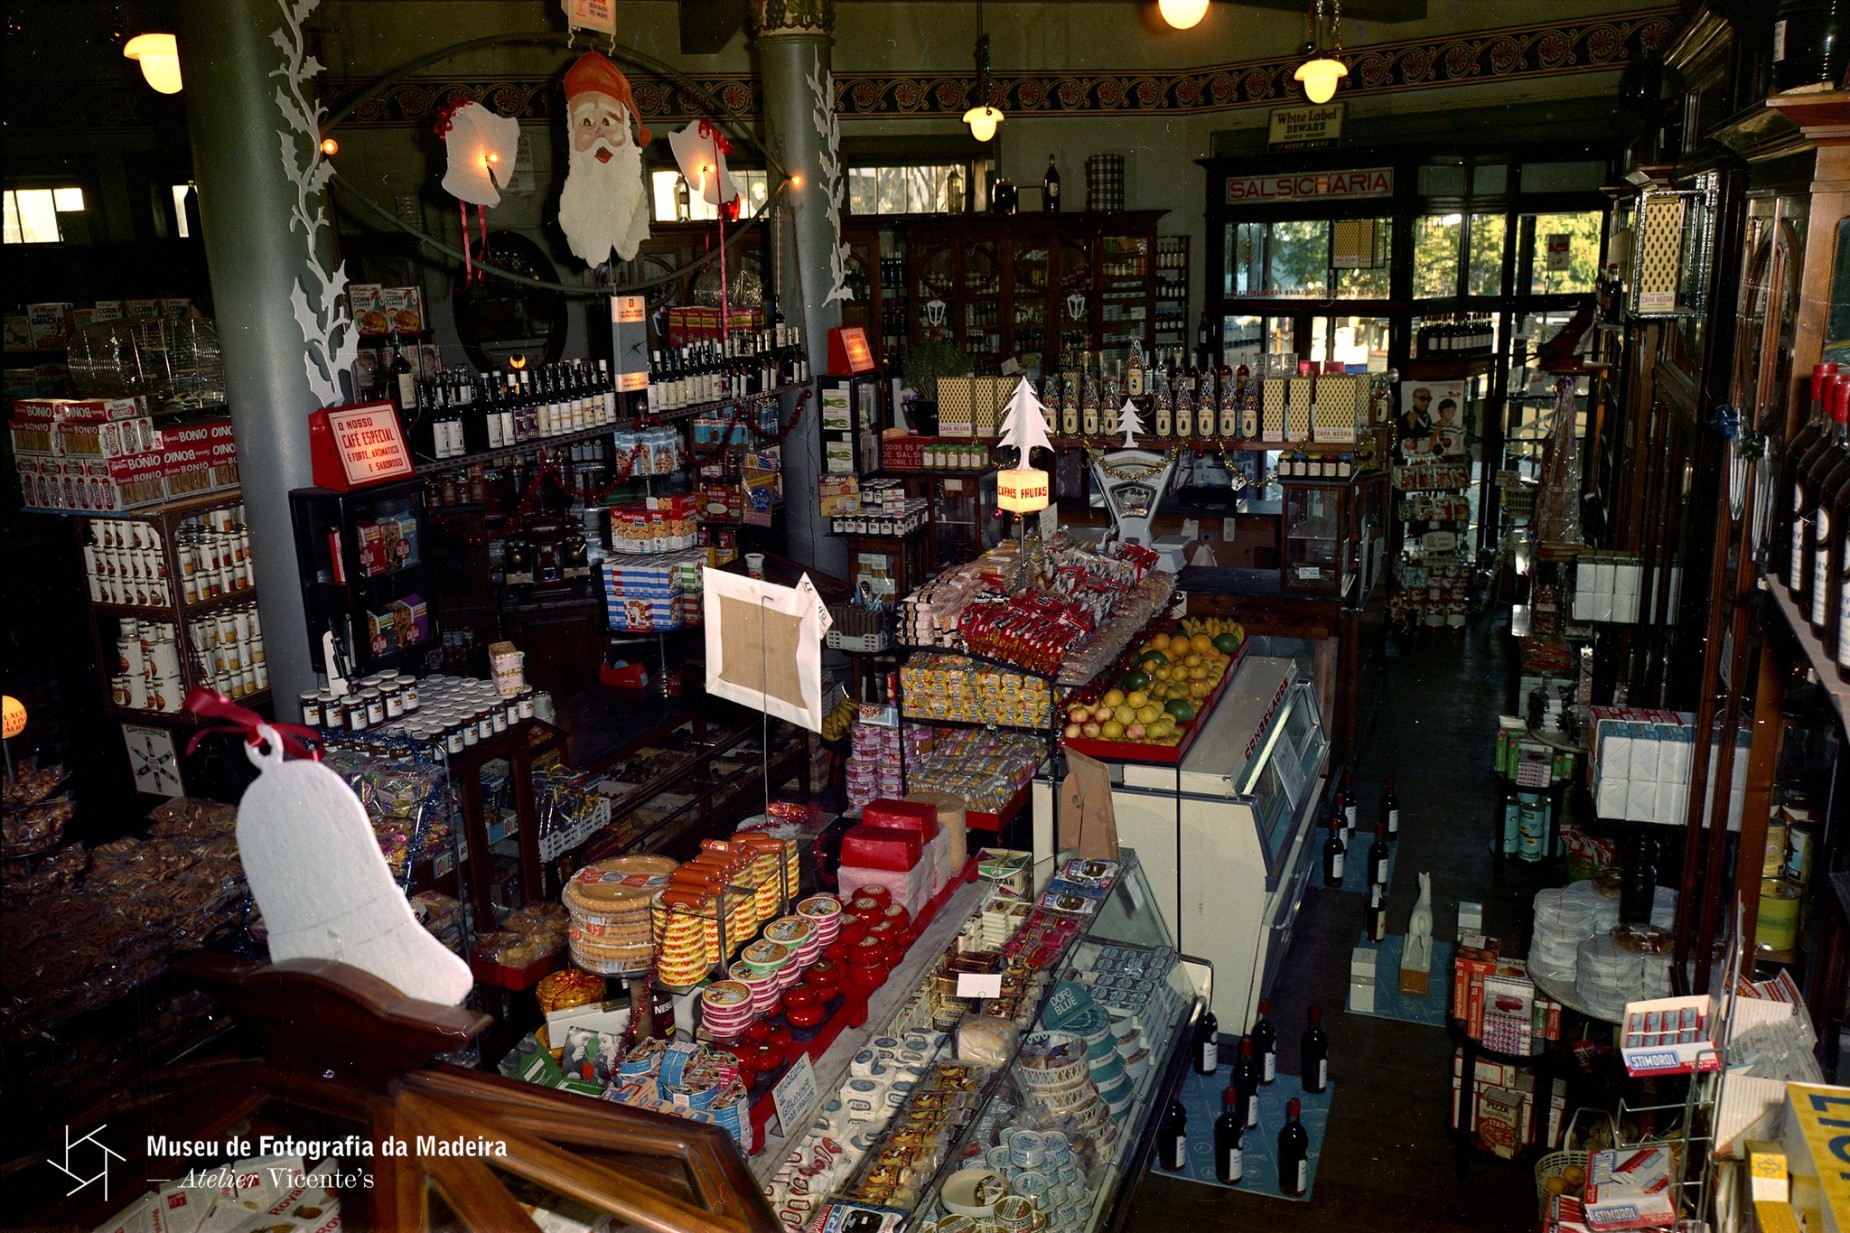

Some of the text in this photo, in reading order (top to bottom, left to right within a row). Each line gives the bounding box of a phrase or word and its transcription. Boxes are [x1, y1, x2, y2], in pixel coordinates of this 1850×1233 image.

[1286, 122, 1326, 133] DEWAR'S
[1229, 172, 1389, 199] SALSICHARIA
[385, 294, 403, 303] CORN
[1641, 296, 1654, 304] CAPA
[26, 406, 52, 417] BONIO
[65, 406, 91, 415] BONIO
[24, 422, 49, 431] BONIO
[74, 425, 98, 435] BONIO
[338, 417, 373, 431] O NOSSO
[178, 428, 208, 443] BONIO
[341, 428, 395, 449] CAFÉ ESPECIAL
[1333, 429, 1352, 437] NEGRA
[163, 449, 196, 463] BONIO
[371, 445, 400, 459] AROMATICO
[128, 455, 161, 470] BONIO
[180, 461, 209, 473] BONIO
[376, 457, 403, 471] SABOROSO
[133, 470, 162, 482] BONIO
[997, 485, 1048, 500] CARNES FRUTAS
[1244, 677, 1289, 760] CONGELADOS
[654, 1001, 673, 1015] NESC
[1054, 997, 1078, 1016] BLUE
[1631, 1051, 1677, 1068] STIMOROL
[1486, 1101, 1509, 1114] PIZZA
[1488, 1118, 1507, 1129] STAR
[1594, 1206, 1637, 1221] STIMOROL
